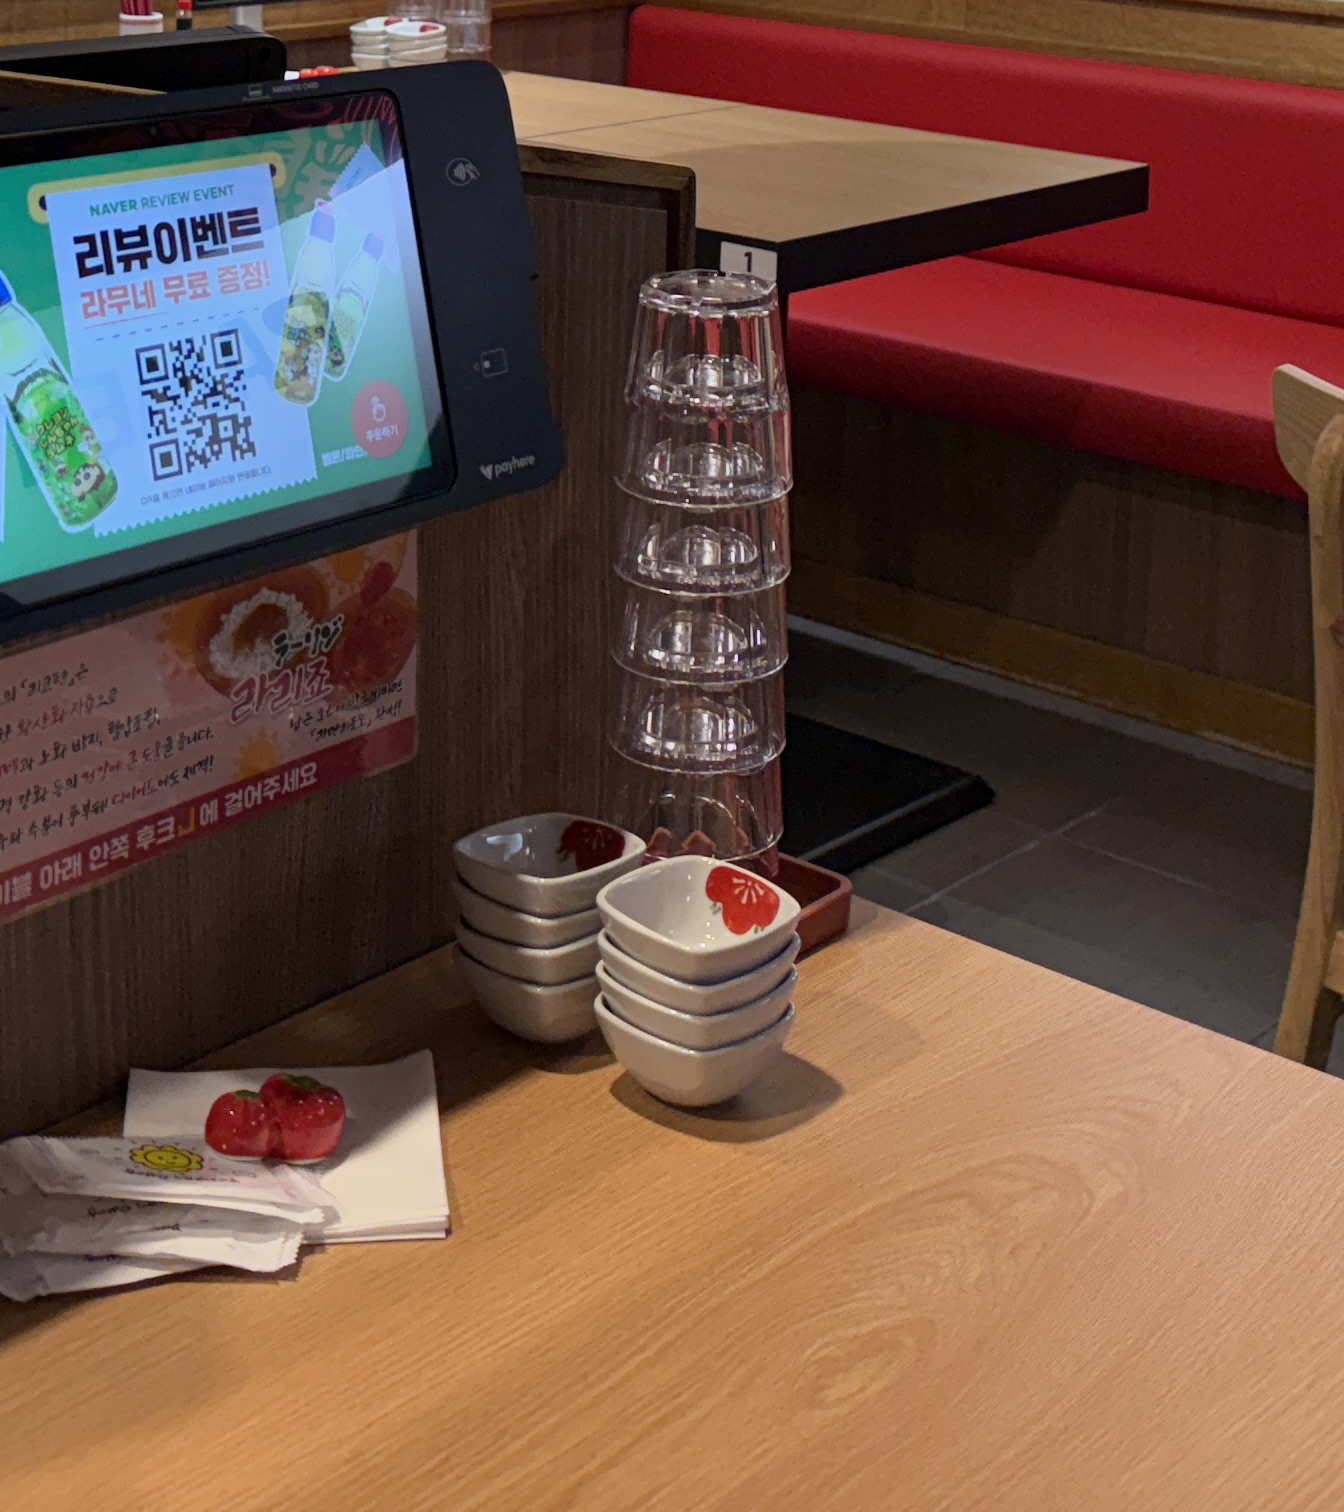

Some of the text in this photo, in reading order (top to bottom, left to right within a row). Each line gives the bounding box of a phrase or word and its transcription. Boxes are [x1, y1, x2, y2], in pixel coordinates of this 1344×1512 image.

[89, 184, 235, 217] NAVER REVIEW EVENT
[72, 206, 265, 279] 리뷰이벤트
[80, 258, 272, 320] 라무네 무료 증정!
[18, 785, 48, 810] 강화
[38, 852, 84, 890] 아래
[88, 835, 131, 873] 안쪽
[135, 814, 177, 852] 후크
[198, 797, 220, 828] 에
[223, 762, 319, 819] 걸어주세요
